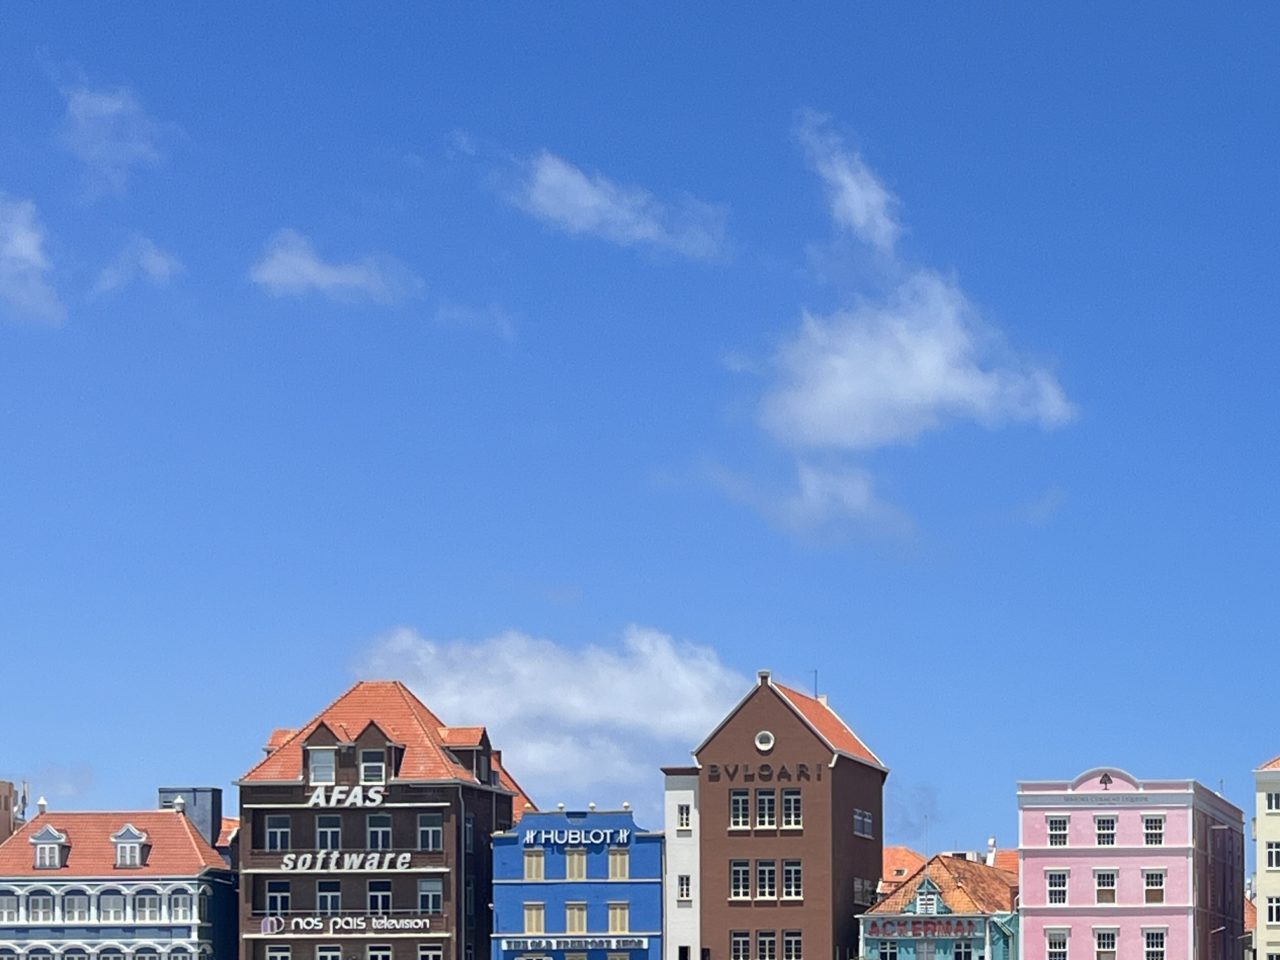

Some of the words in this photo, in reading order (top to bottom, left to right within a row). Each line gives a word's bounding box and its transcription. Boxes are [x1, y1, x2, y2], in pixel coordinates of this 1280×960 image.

[708, 764, 822, 782] BVLGARI
[308, 786, 385, 807] AFAS
[541, 829, 614, 844] HUBLOT
[281, 849, 412, 871] software
[291, 916, 324, 930] nos
[329, 916, 367, 935] pais
[371, 915, 430, 930] television
